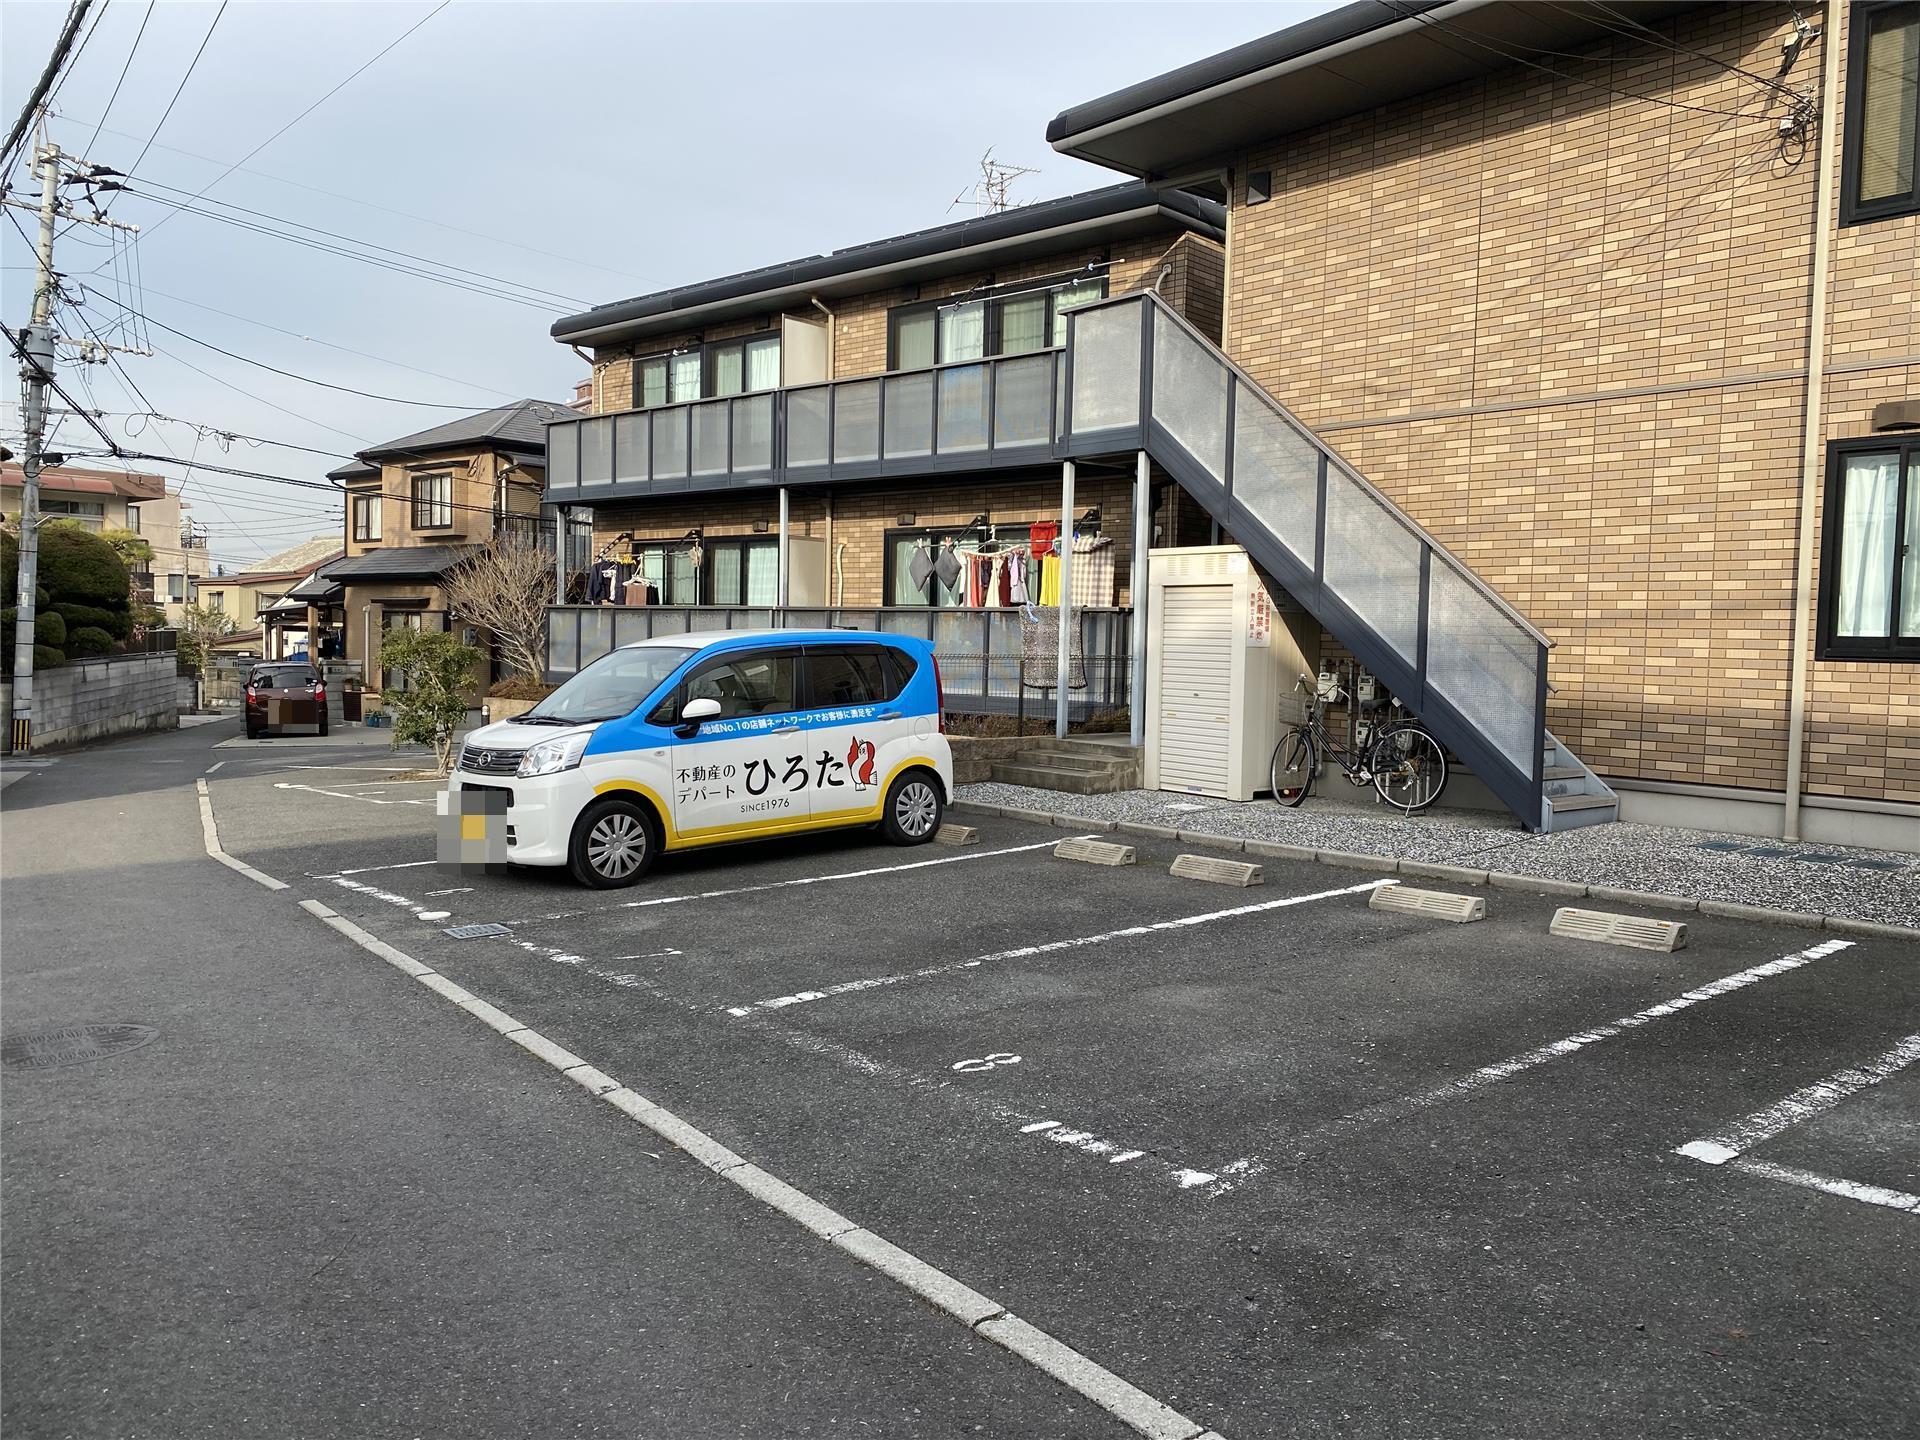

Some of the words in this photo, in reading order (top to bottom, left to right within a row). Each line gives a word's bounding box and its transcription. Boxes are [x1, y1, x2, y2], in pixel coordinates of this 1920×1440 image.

[676, 764, 736, 784] 不動産の
[743, 750, 845, 796] ひろた
[677, 785, 736, 804] デパート
